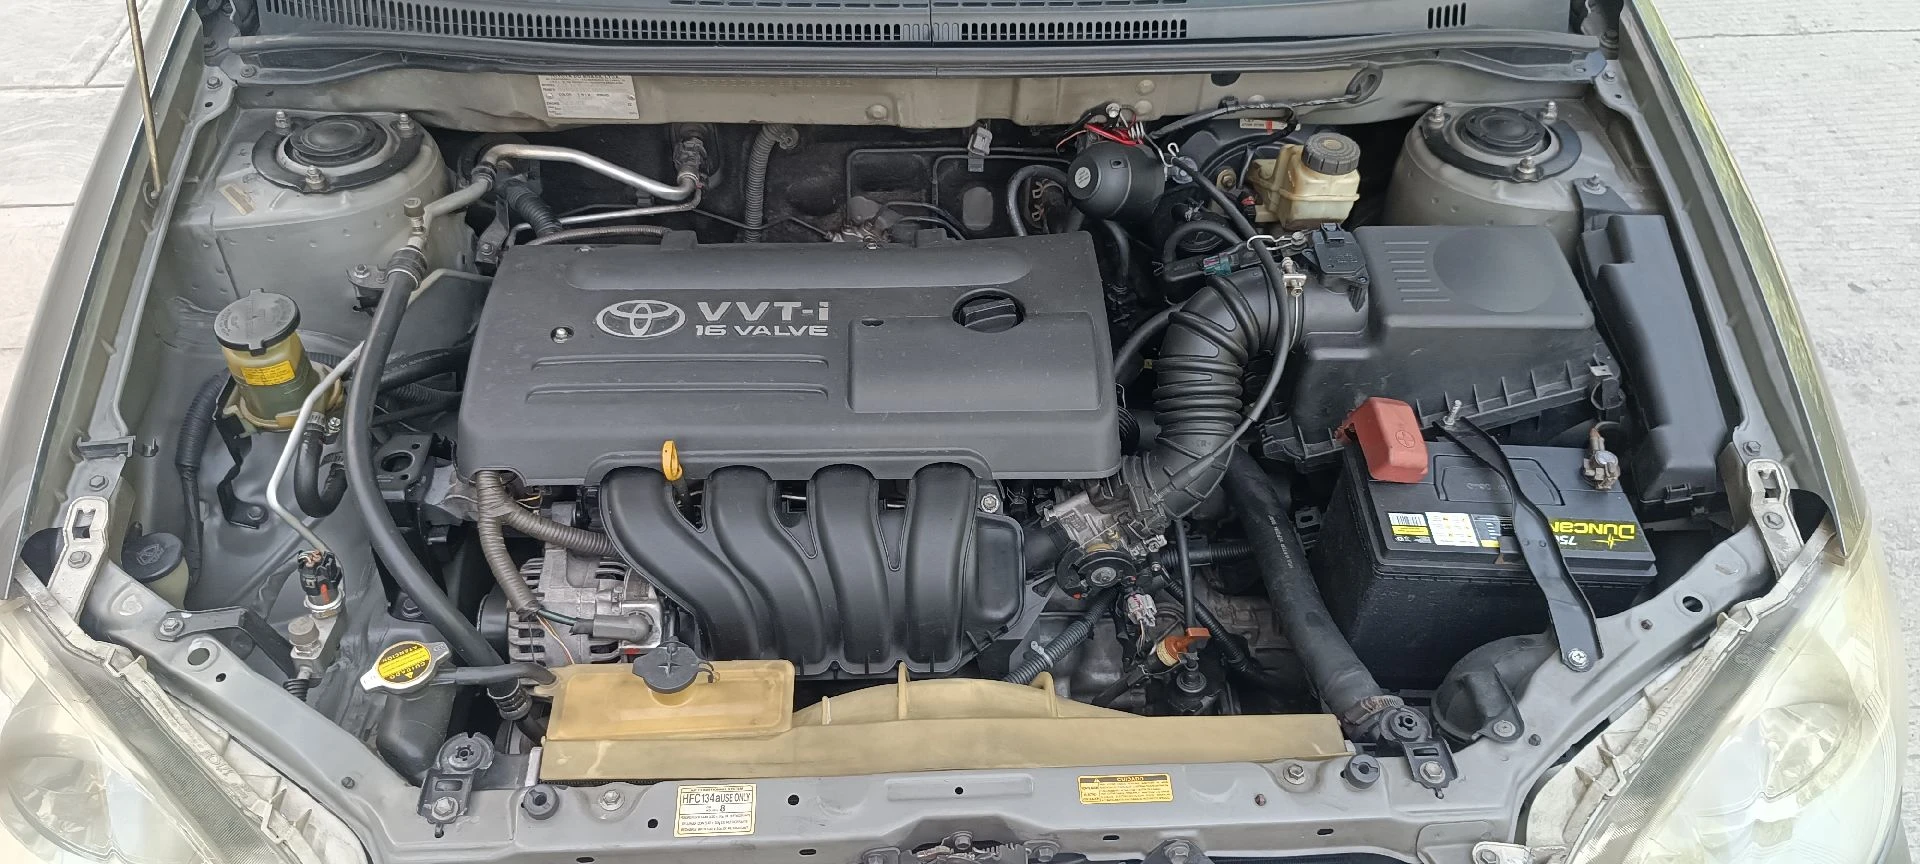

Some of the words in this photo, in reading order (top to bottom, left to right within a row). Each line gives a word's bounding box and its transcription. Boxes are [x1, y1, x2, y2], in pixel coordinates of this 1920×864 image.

[697, 301, 829, 322] VVT-i
[695, 324, 727, 336] 16
[734, 324, 829, 336] VALVE
[734, 792, 751, 802] ONLY
